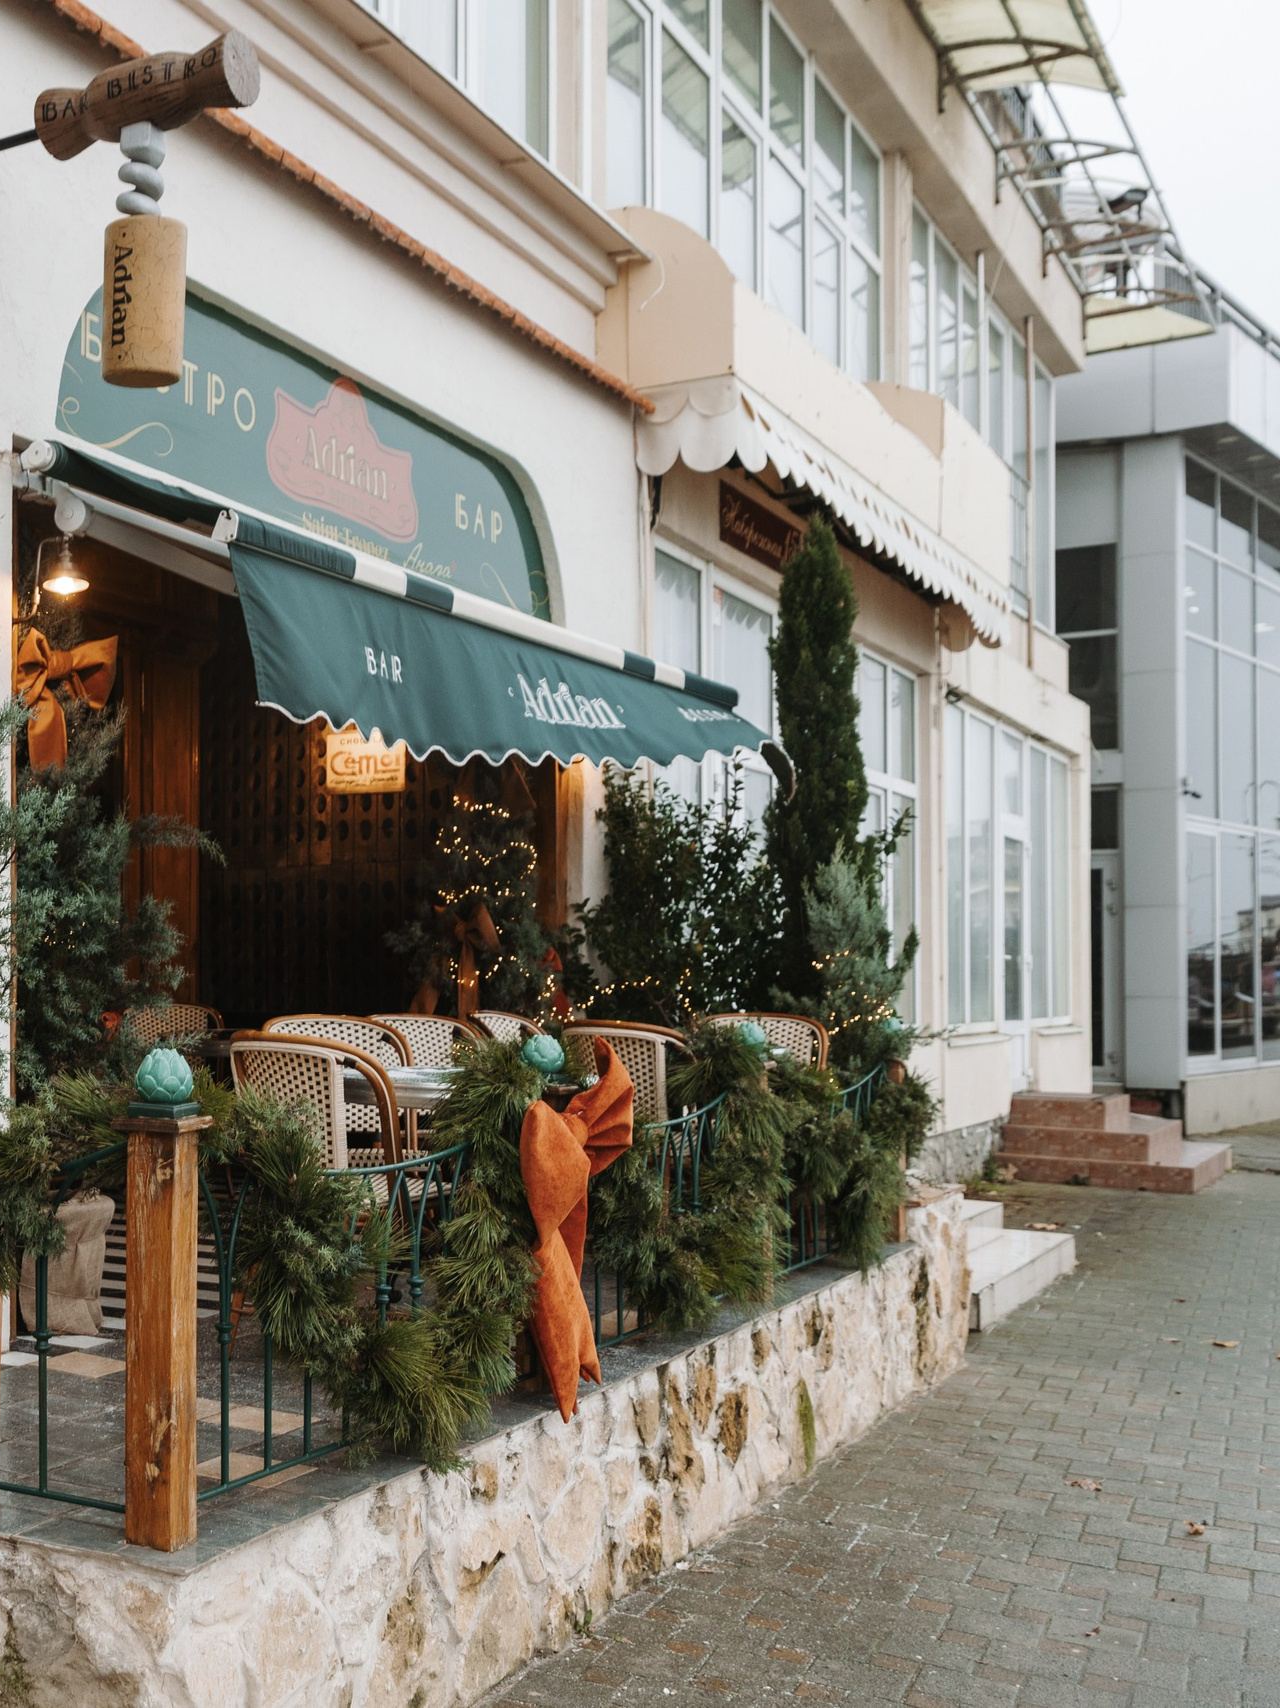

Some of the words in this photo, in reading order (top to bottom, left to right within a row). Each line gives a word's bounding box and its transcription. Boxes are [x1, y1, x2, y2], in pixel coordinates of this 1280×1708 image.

[41, 93, 90, 123] BAR
[106, 47, 218, 100] BISTRO
[111, 243, 134, 348] Adrian
[80, 309, 257, 433] БТРО
[301, 425, 390, 503] Adrian
[455, 492, 503, 544] БАР
[364, 645, 403, 684] BAR
[516, 673, 626, 729] Adrian
